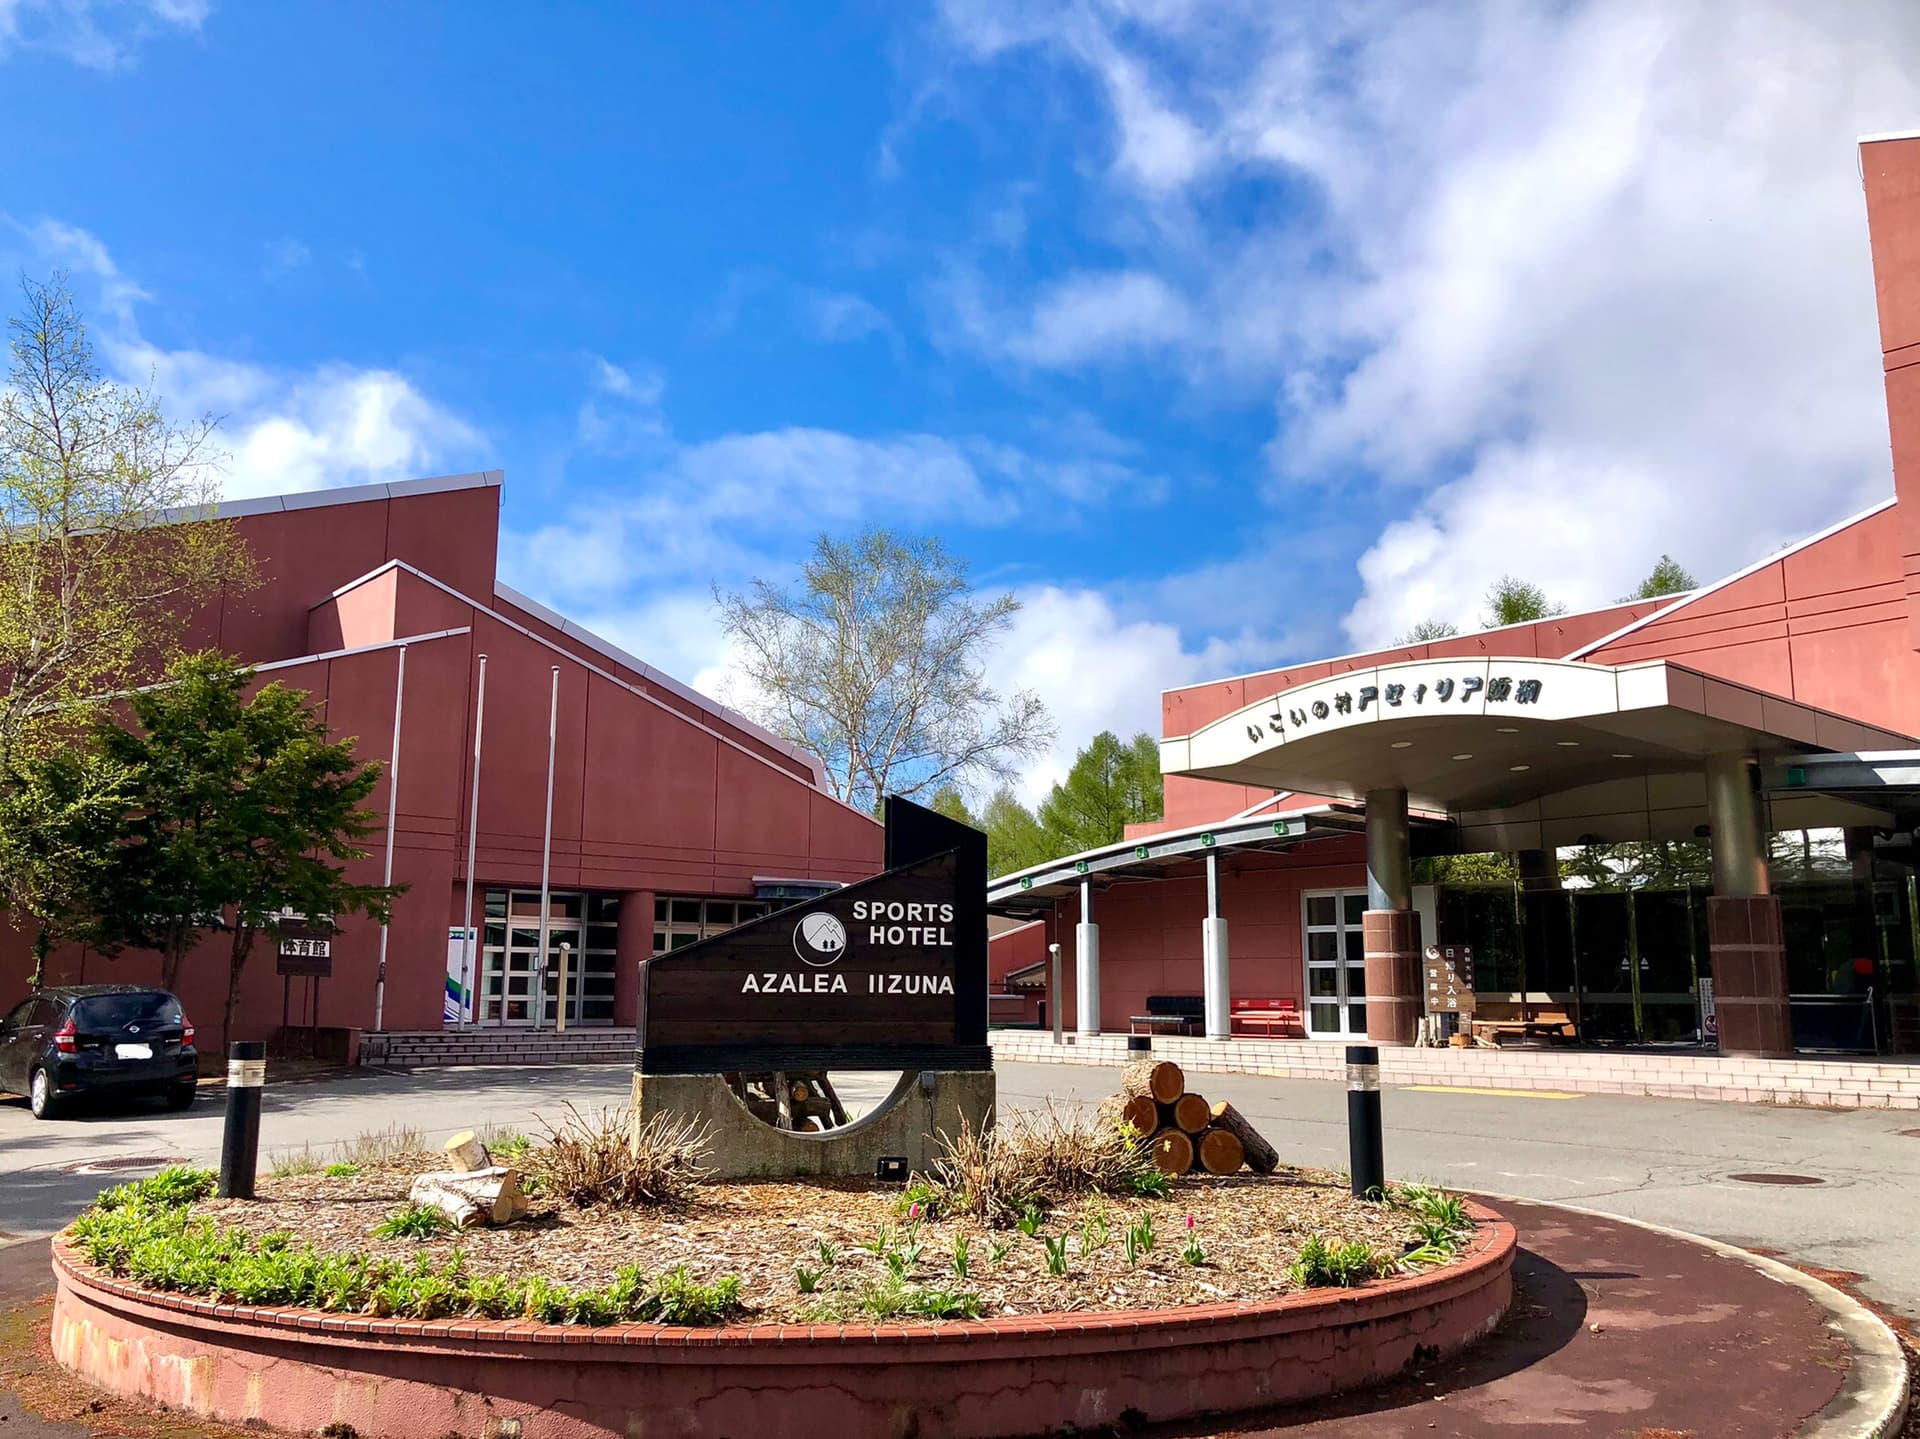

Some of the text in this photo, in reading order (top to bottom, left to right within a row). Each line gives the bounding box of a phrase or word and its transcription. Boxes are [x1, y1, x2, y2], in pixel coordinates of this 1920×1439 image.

[853, 901, 954, 923] SPORTS
[869, 926, 953, 946] HOTEL
[282, 939, 327, 956] 体育館
[741, 973, 955, 995] AZALEA IIZUNA
[1445, 948, 1457, 1008] 日帰り入浴
